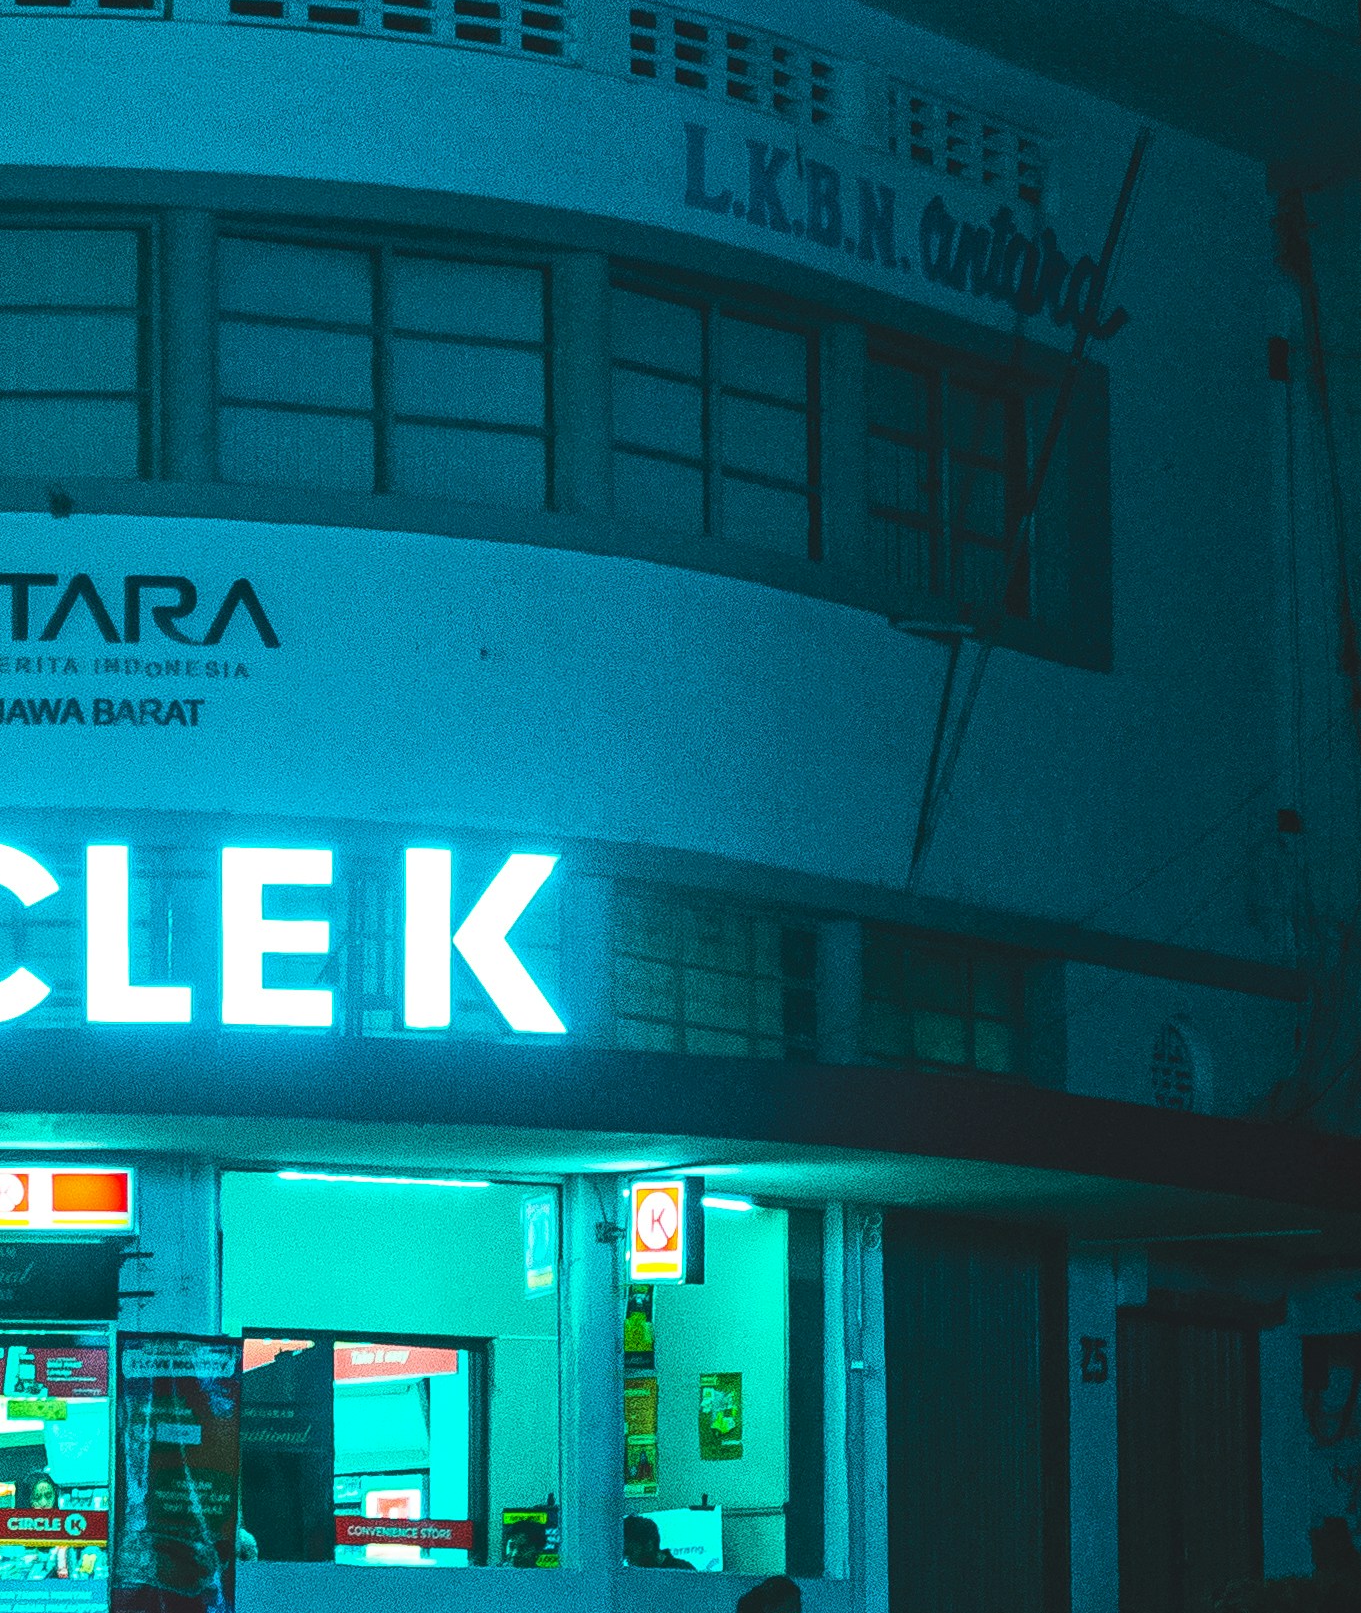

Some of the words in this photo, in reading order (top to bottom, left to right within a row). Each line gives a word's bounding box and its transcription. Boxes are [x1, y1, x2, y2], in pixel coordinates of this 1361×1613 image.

[93, 656, 251, 680] INDONESIA
[92, 697, 205, 728] BARAT
[403, 846, 570, 1034] K
[7, 1516, 62, 1532] CIRCLE
[347, 1525, 419, 1539] CONVENIENCE
[420, 1527, 452, 1540] STORE
